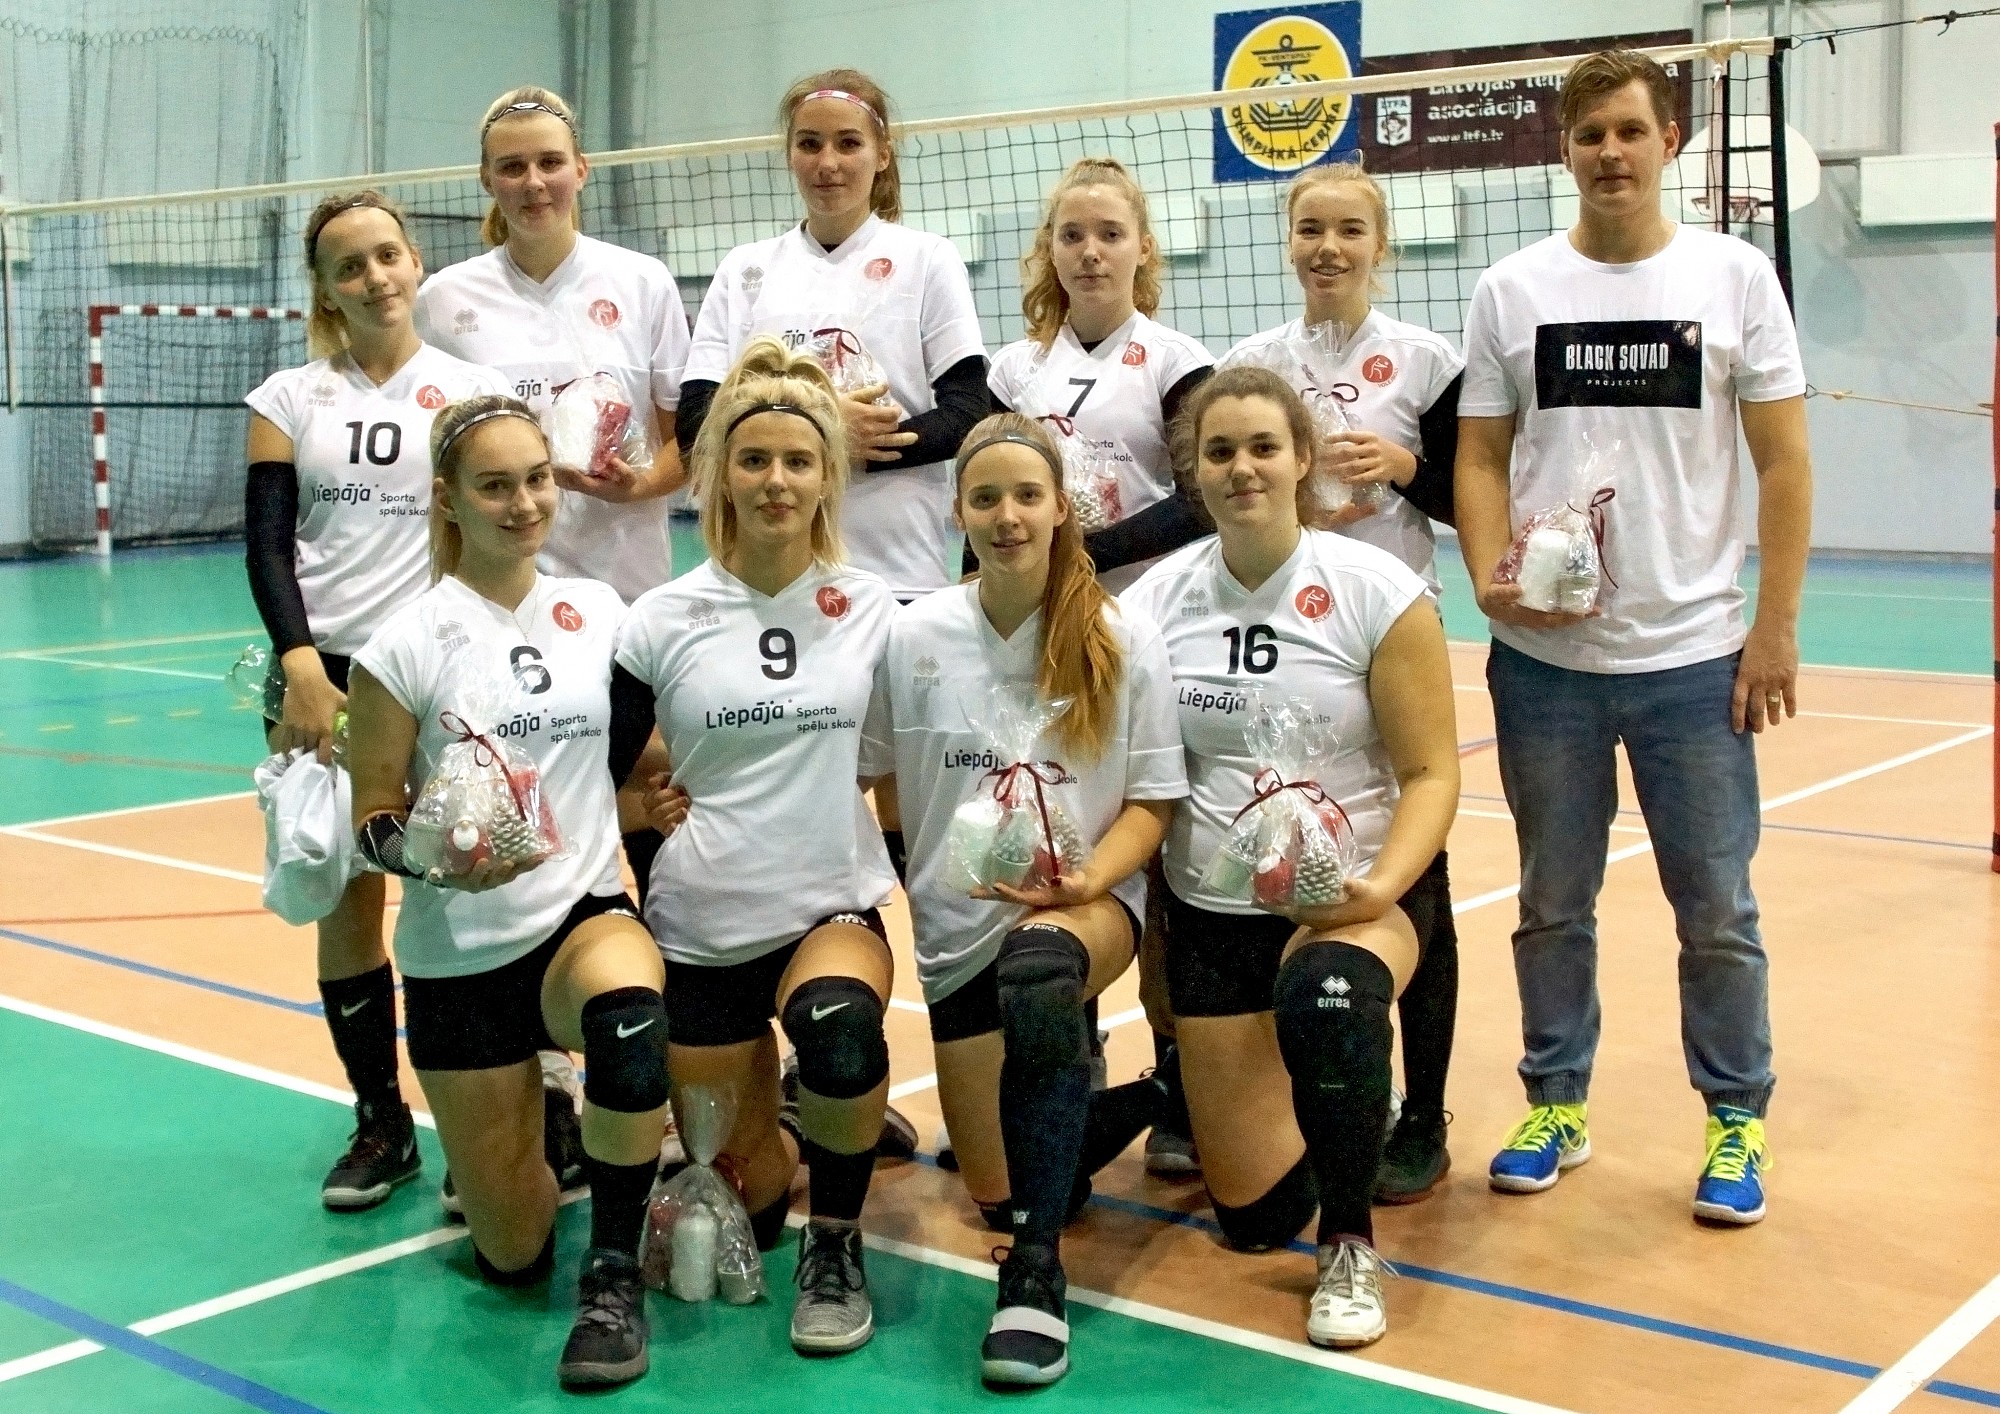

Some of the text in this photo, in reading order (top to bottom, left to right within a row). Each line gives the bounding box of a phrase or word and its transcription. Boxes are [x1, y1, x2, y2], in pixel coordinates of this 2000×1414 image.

[1427, 95, 1537, 120] asociācija
[1565, 344, 1614, 371] BLACK
[1586, 379, 1647, 387] PROJECTS
[1068, 377, 1097, 418] 7
[345, 421, 402, 466] 10
[380, 493, 416, 504] Sporta
[379, 506, 430, 517] spēļu skol
[1181, 606, 1209, 617] errea
[688, 616, 721, 631] errea
[758, 627, 797, 681] 9
[1222, 624, 1279, 675] 16
[509, 645, 552, 694] 6
[1178, 686, 1247, 715] Liepāja
[550, 714, 588, 728] Sporta
[706, 700, 784, 729] Liepāja
[796, 705, 837, 719] Sporta
[579, 727, 602, 738] skola
[796, 718, 857, 734] spēļu skola
[945, 749, 1000, 771] Liepāj
[1317, 997, 1350, 1008] errea
